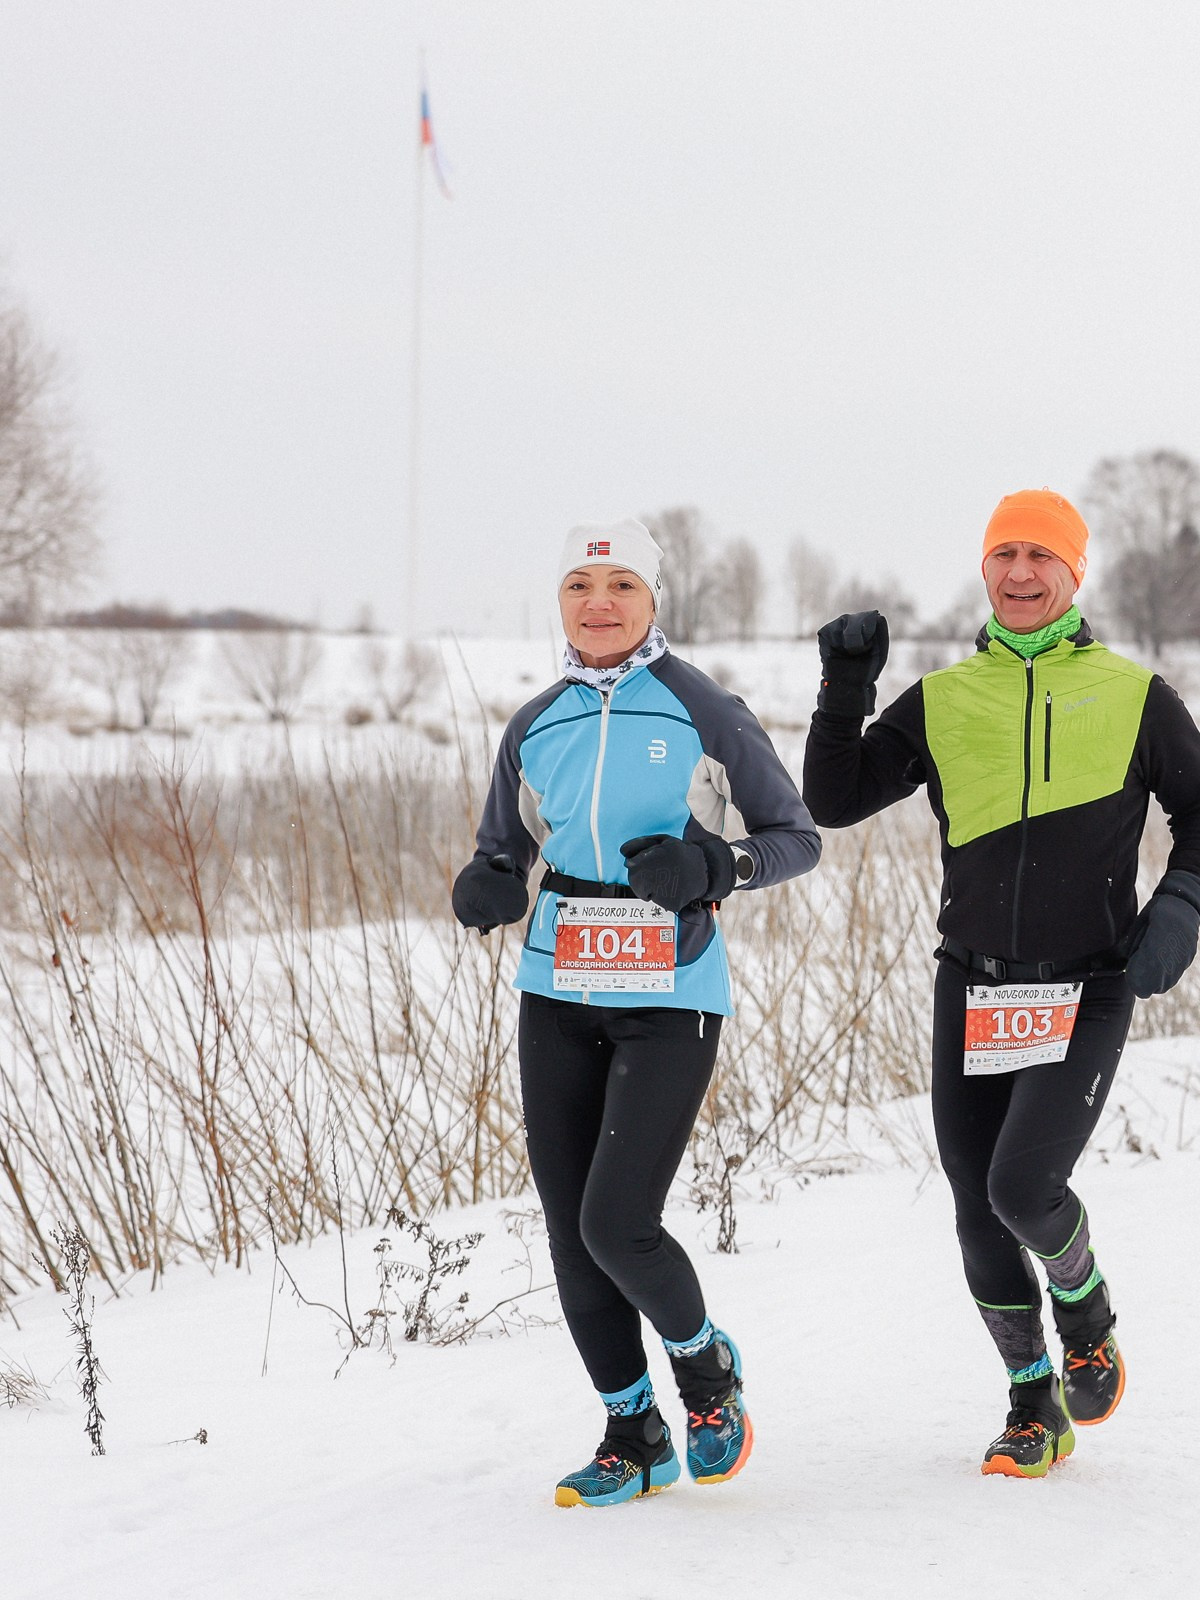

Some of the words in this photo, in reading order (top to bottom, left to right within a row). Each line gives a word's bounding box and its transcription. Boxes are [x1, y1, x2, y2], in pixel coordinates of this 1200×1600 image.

[582, 906, 628, 919] NOVGOROD
[630, 907, 645, 919] ICE
[578, 928, 646, 960] 104
[560, 960, 617, 969] СЛОБОДЯНЮК
[618, 961, 668, 969] ЕКАТЕРИНА
[994, 989, 1040, 1000] NOVGOROD
[1042, 989, 1055, 1000] ICE
[992, 1008, 1053, 1039] 103
[970, 1039, 1026, 1050] СЛОБОДЯНЮК
[1026, 1033, 1066, 1046] АЛЕКСАНДР
